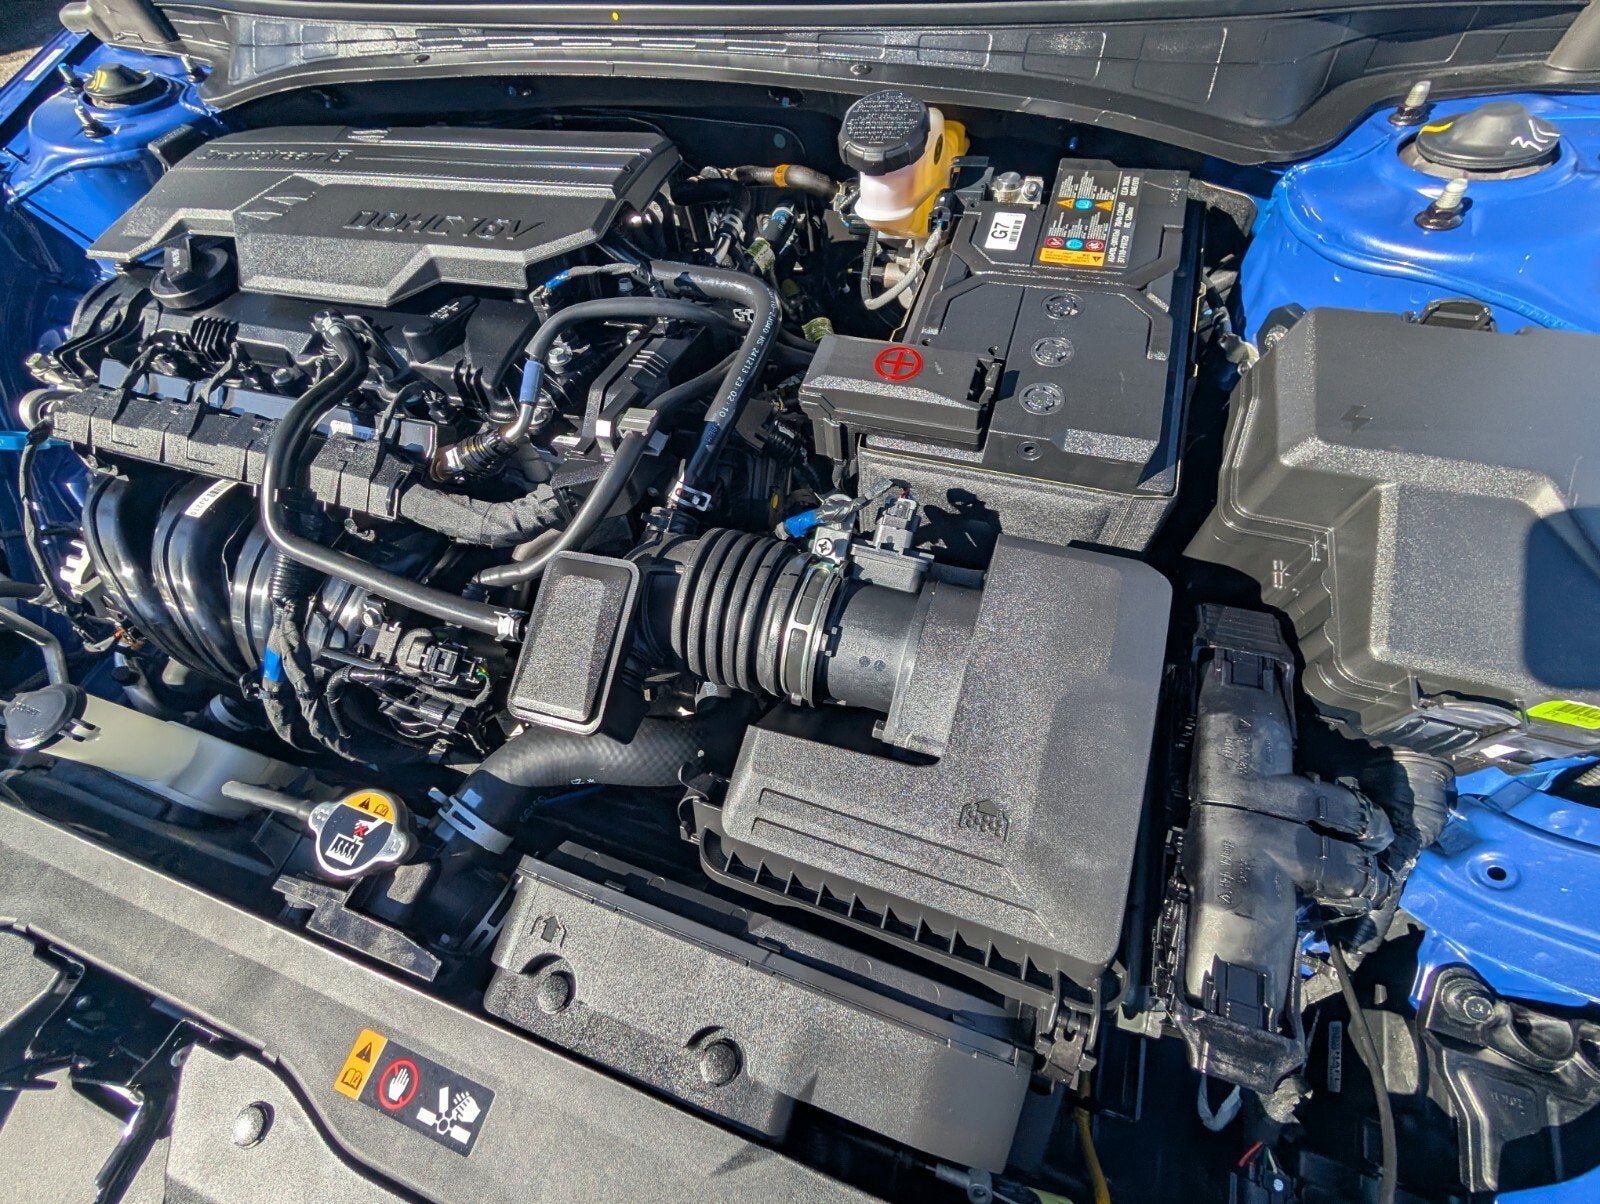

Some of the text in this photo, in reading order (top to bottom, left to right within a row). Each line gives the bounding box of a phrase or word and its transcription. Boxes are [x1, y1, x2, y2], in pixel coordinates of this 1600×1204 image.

[342, 210, 545, 240] DOHC 16V
[991, 221, 1010, 239] G7
[742, 347, 760, 374] 241213
